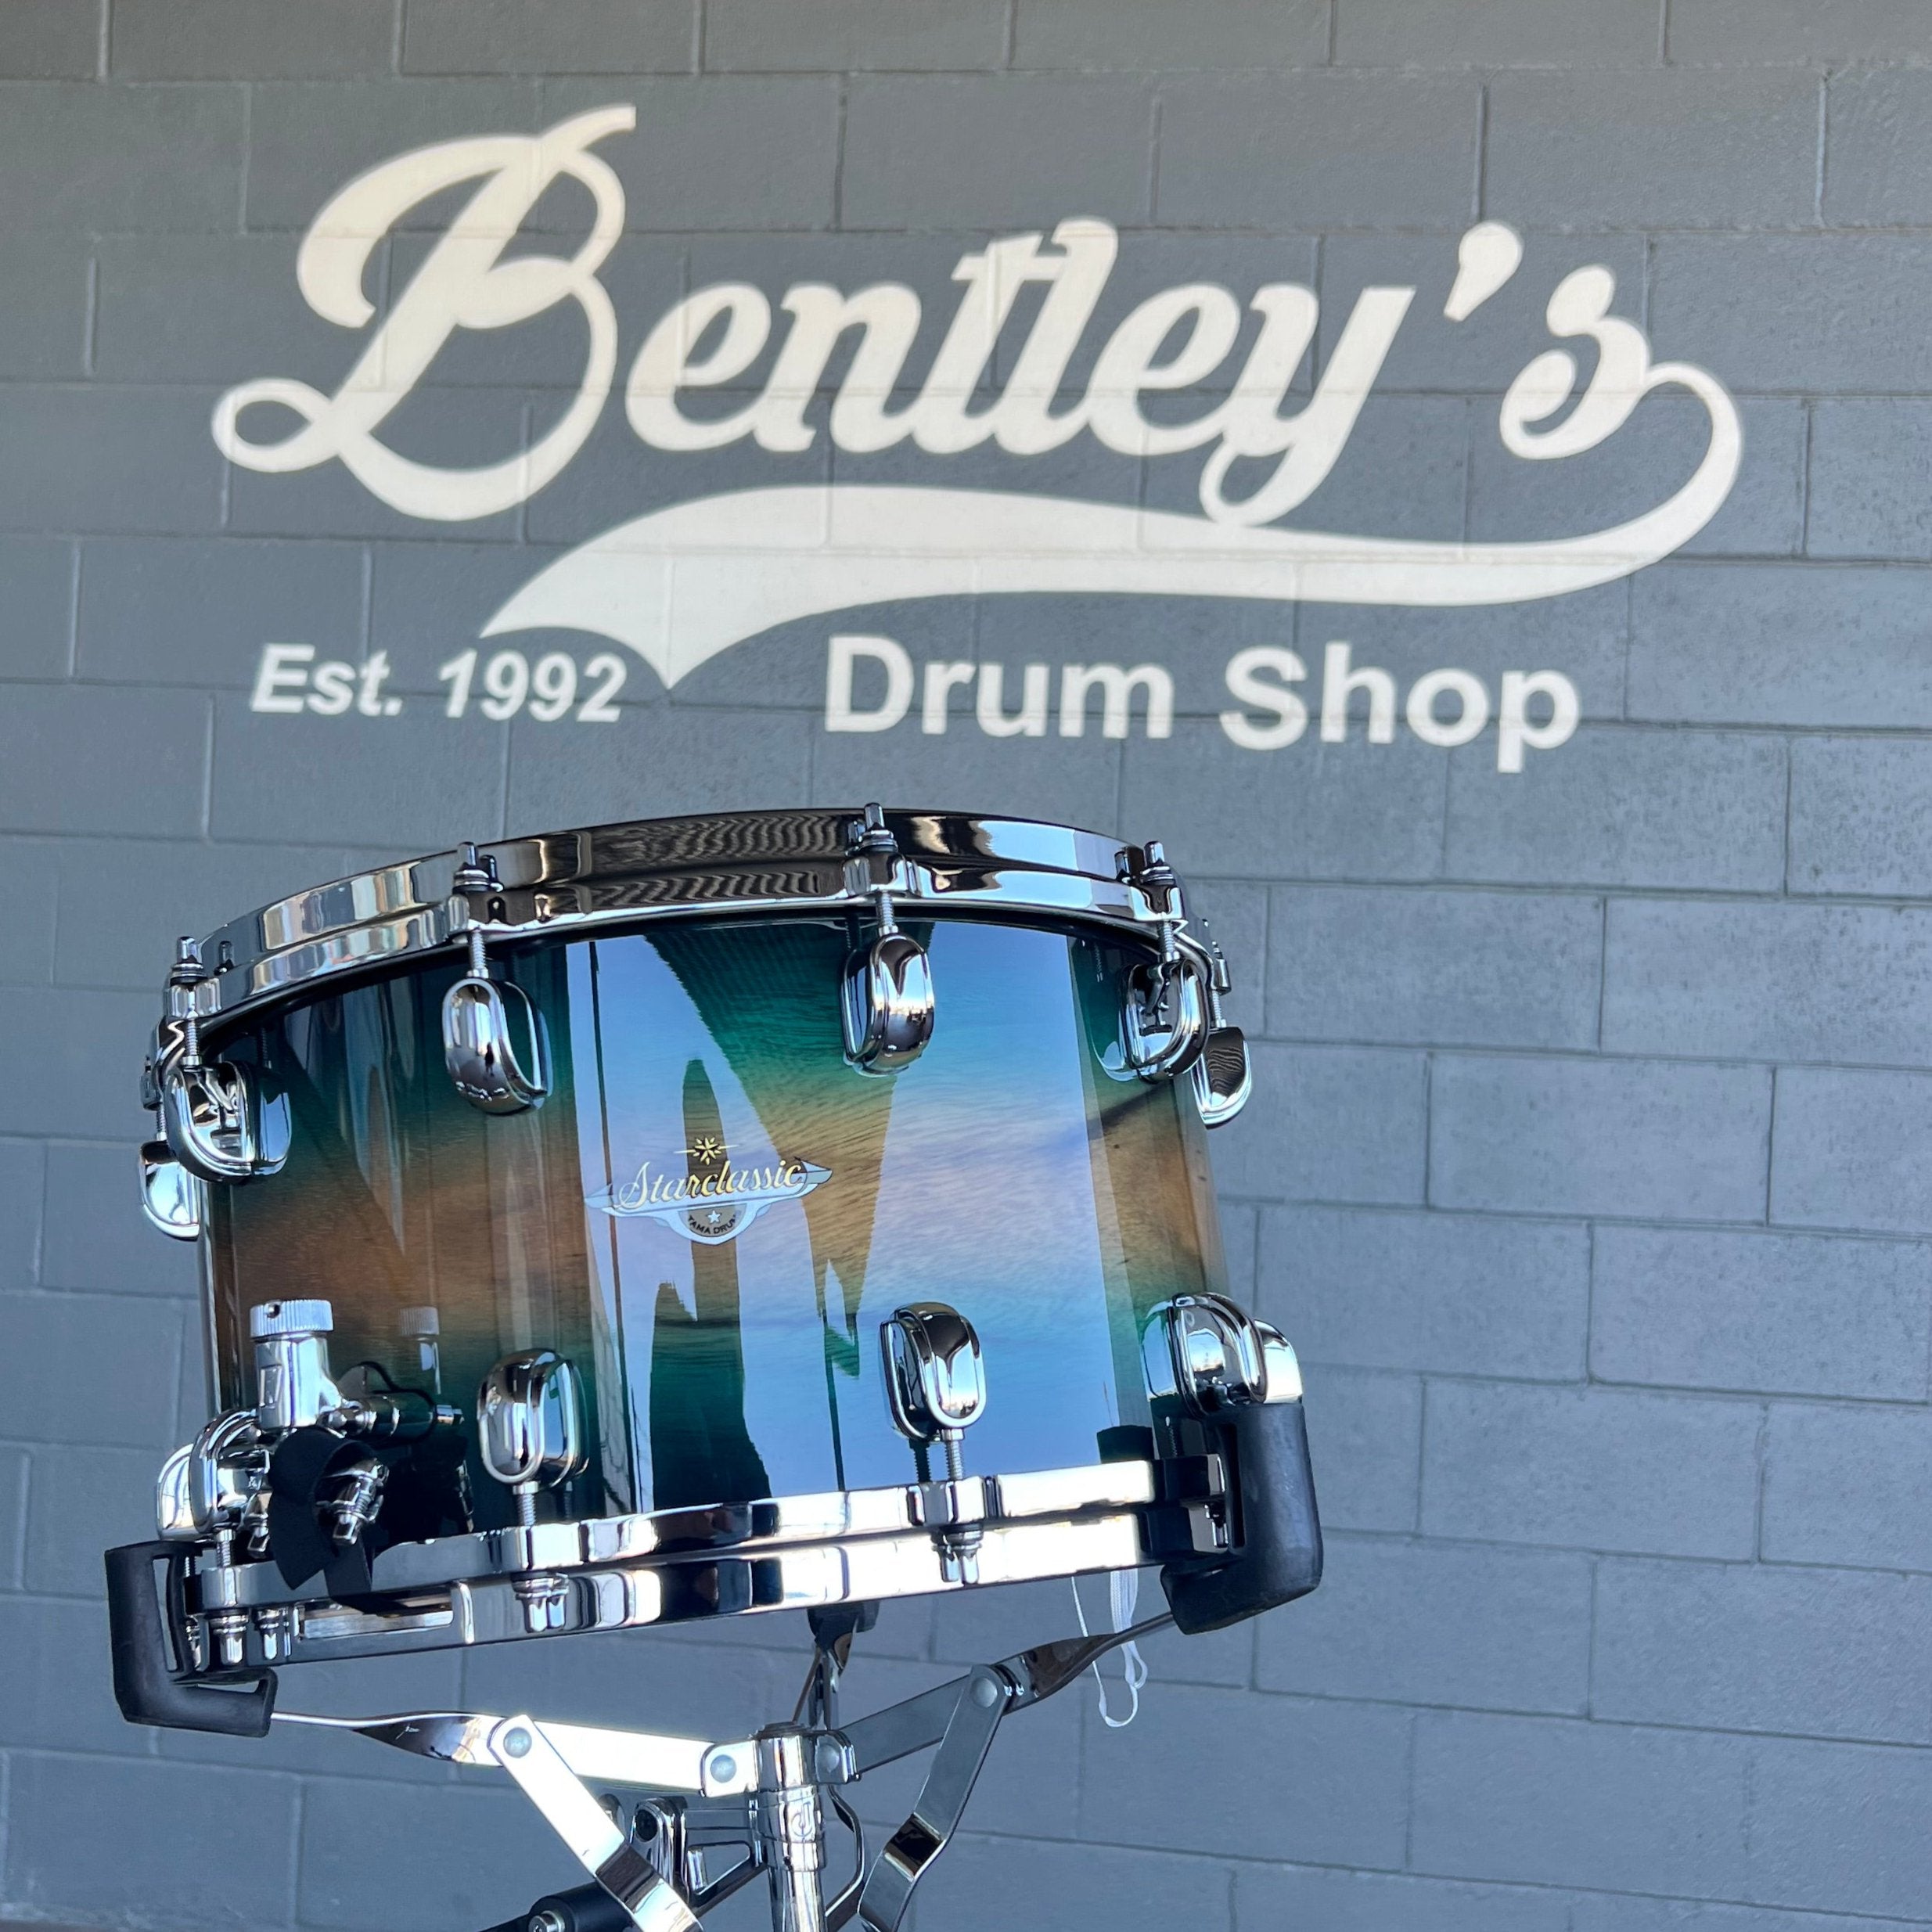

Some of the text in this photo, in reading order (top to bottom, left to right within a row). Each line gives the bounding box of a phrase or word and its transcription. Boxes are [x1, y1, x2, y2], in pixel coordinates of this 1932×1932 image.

[211, 105, 1743, 527] Bentley's
[250, 642, 628, 723] Est. 1992
[824, 635, 1581, 774] Drum Shop
[614, 1160, 803, 1209] Starclassic
